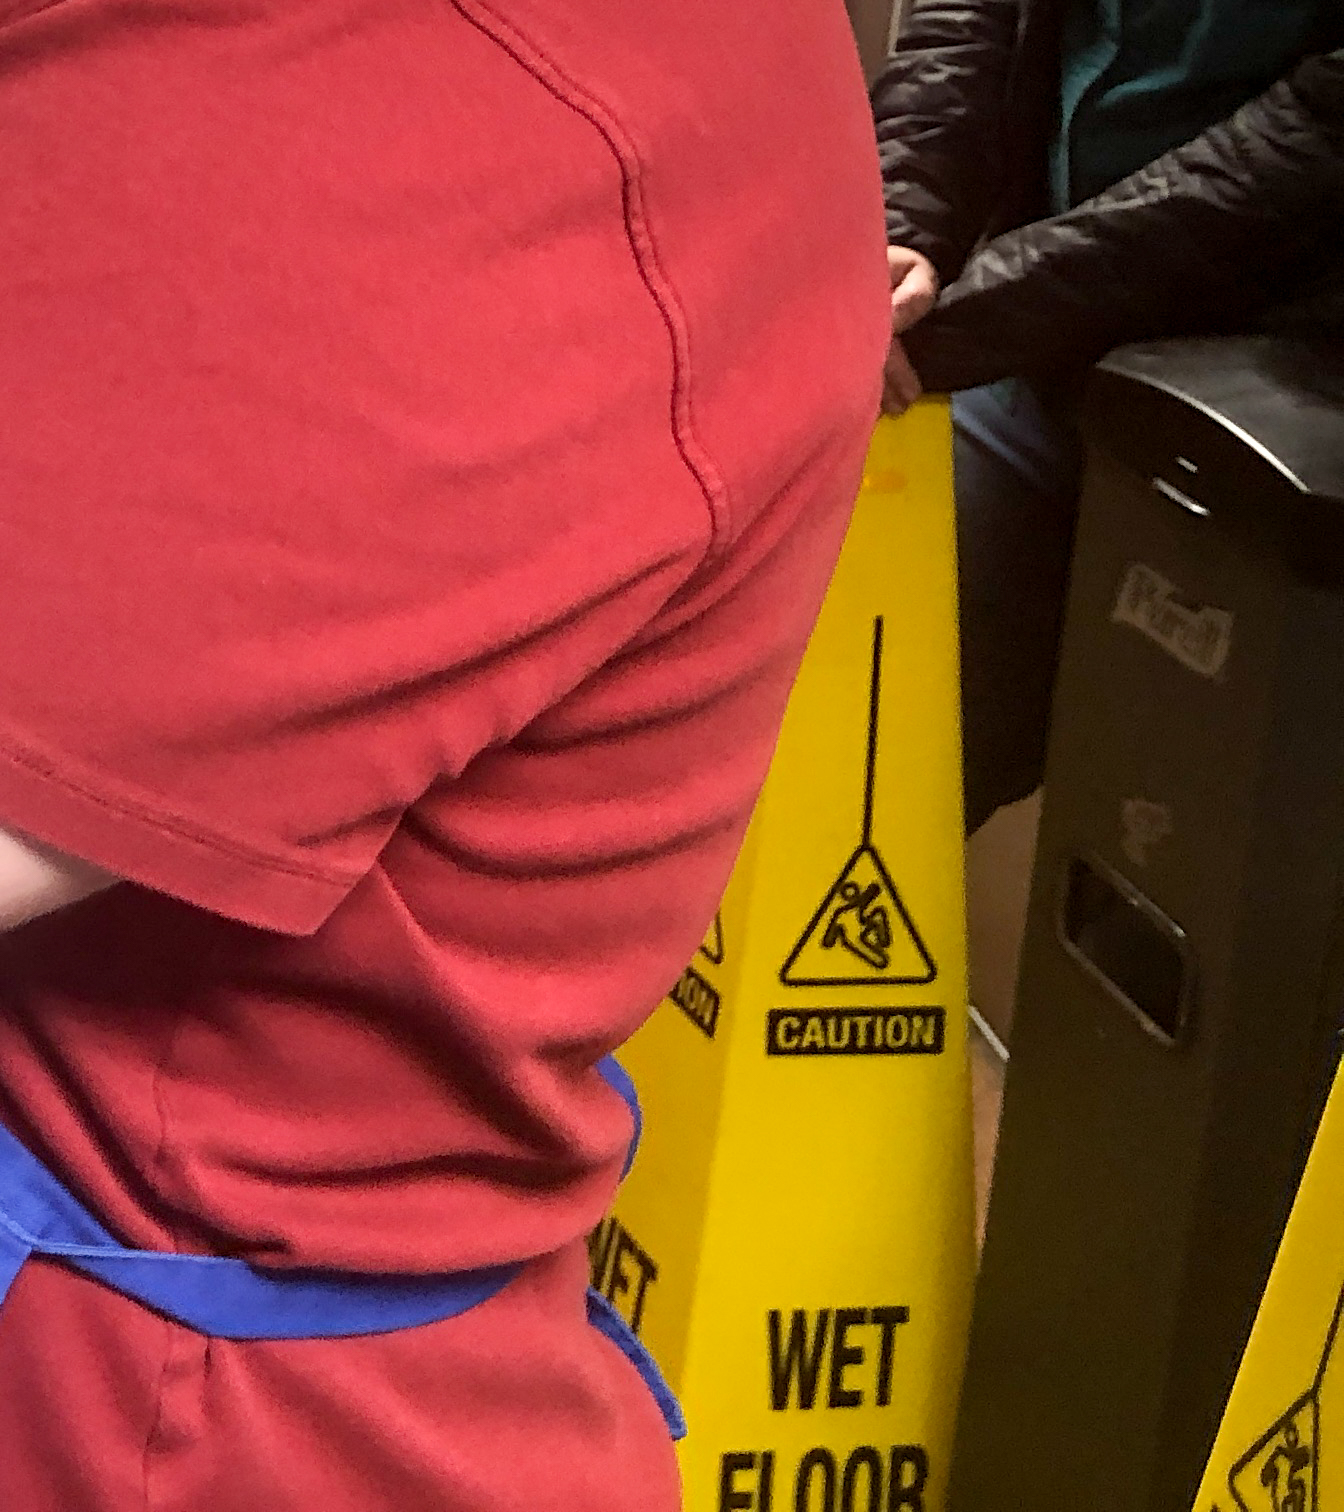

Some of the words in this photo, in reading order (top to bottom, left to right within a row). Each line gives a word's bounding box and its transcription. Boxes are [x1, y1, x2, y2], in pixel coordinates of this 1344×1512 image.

[777, 1016, 935, 1049] CAUTION
[767, 1305, 910, 1411] WET
[720, 1445, 930, 1512] FLOOR
